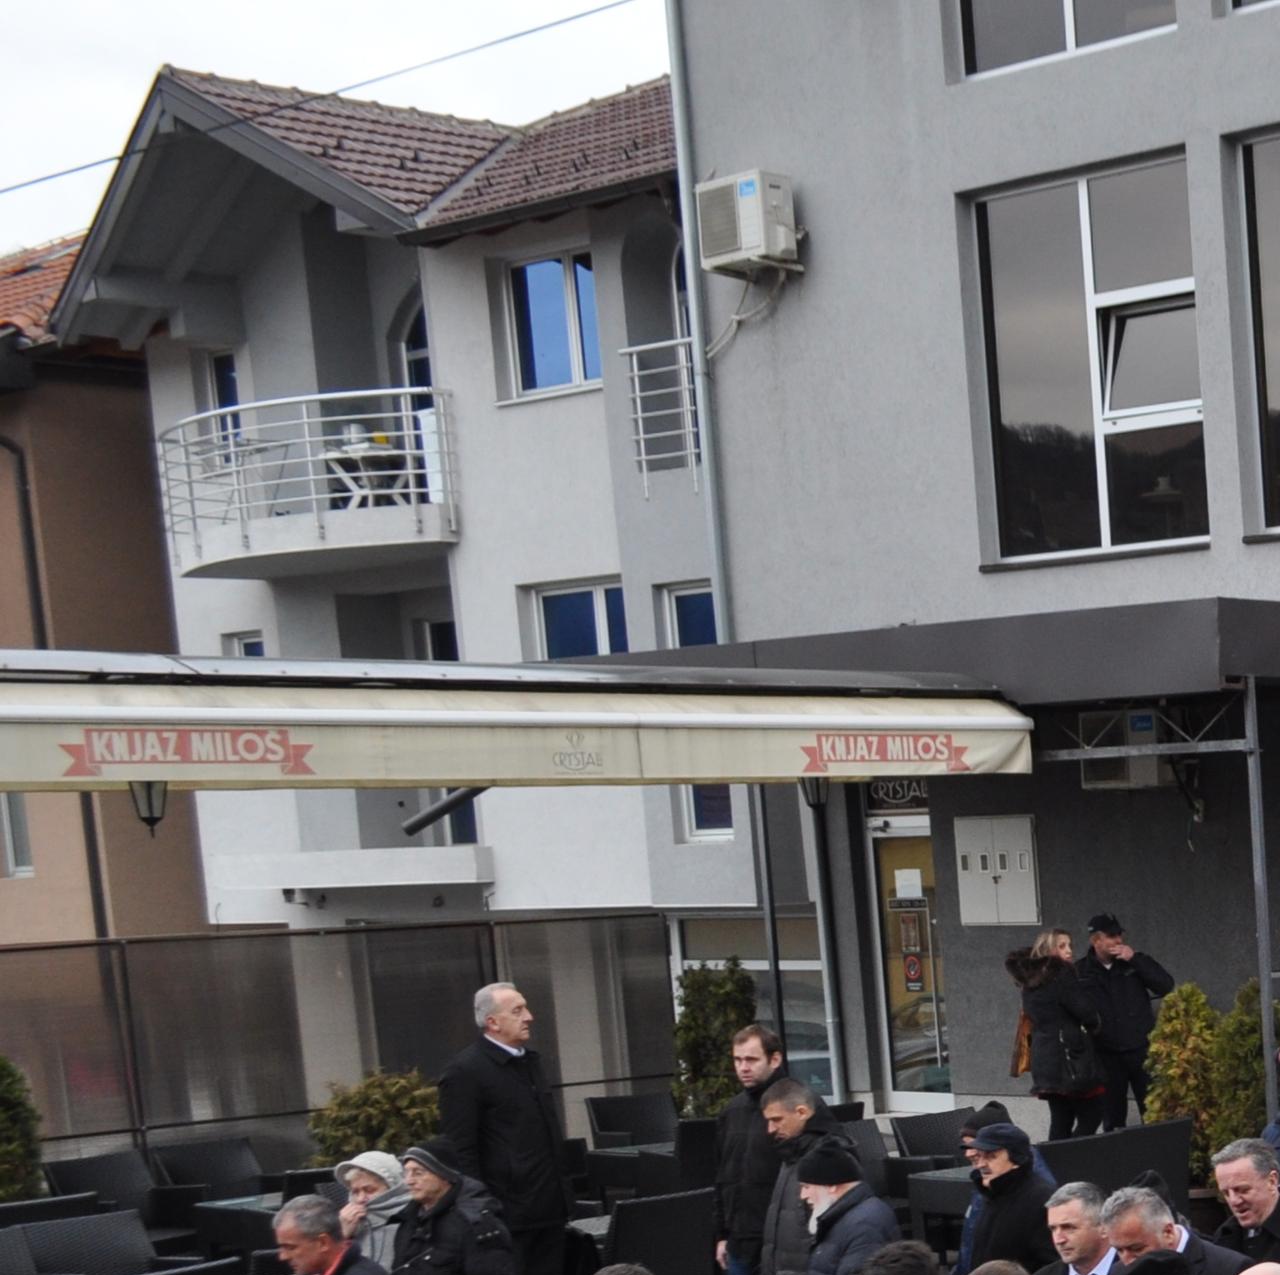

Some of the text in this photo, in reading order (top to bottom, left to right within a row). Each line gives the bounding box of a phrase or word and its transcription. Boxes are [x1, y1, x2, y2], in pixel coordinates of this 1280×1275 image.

[90, 727, 283, 761] KNJAZ MILOŠ
[822, 733, 949, 761] KNJAZ MILOŠ
[552, 751, 603, 771] CRYSTAL
[870, 778, 929, 804] CRYSTAL
